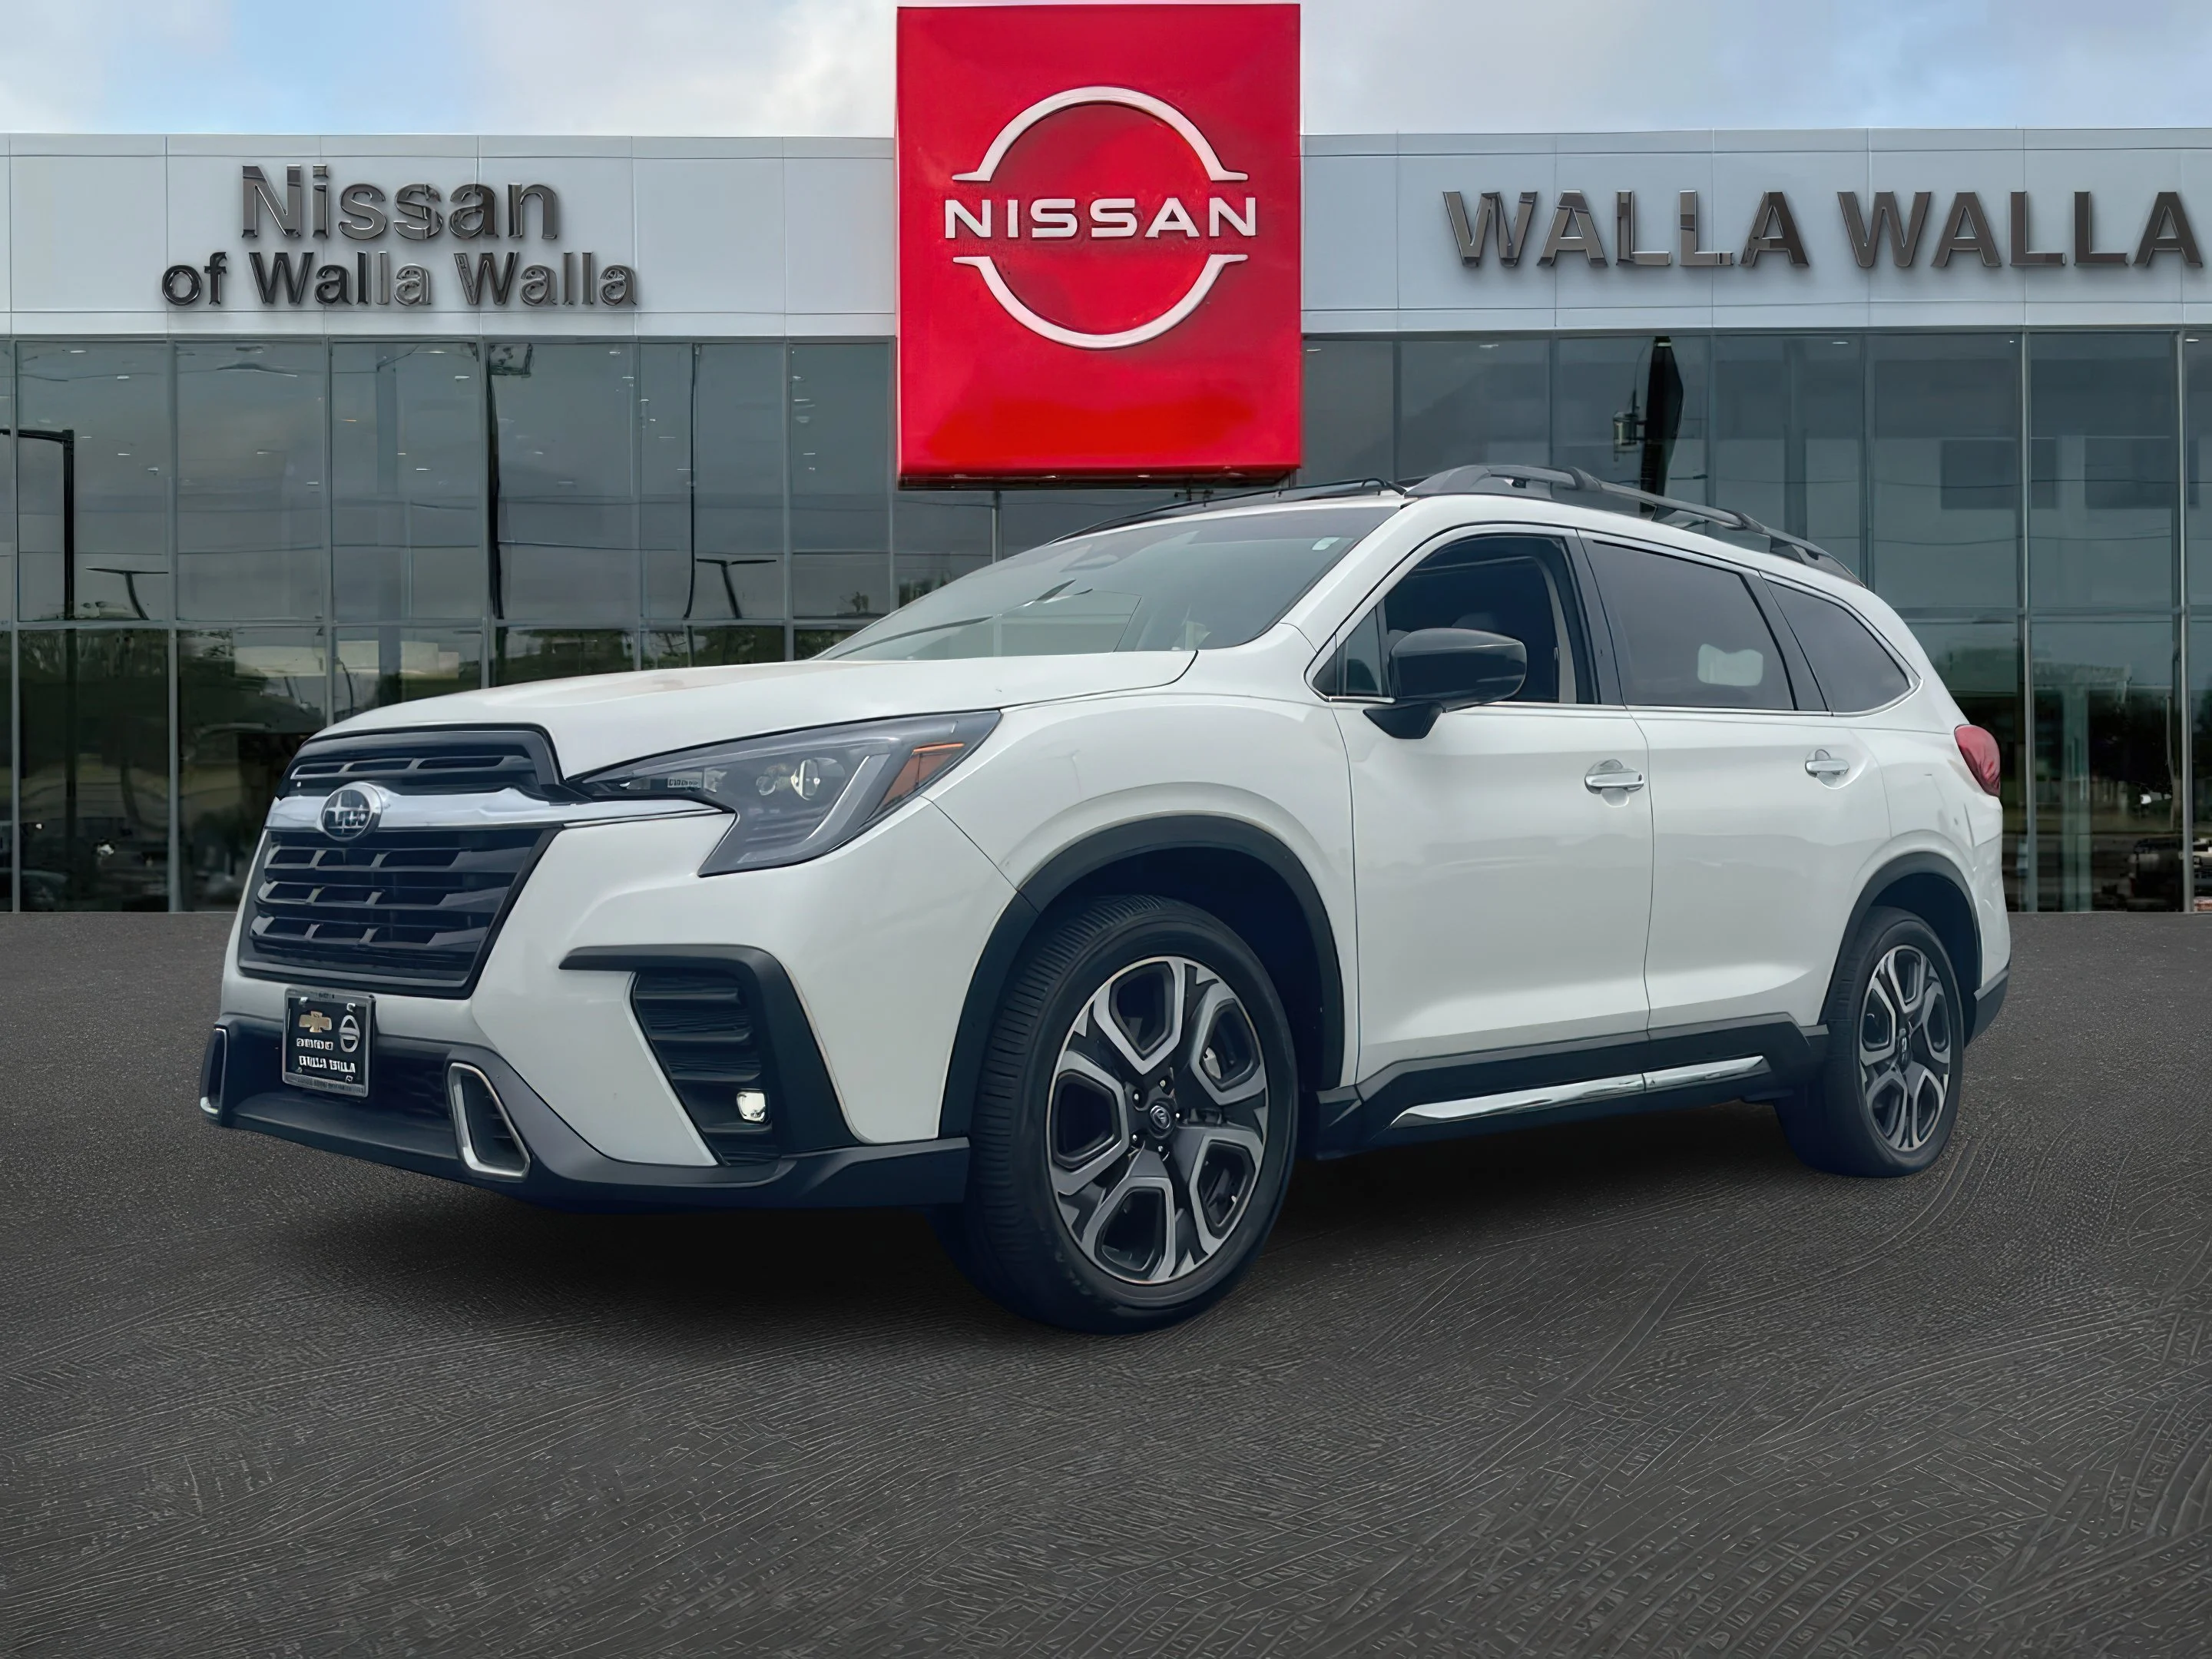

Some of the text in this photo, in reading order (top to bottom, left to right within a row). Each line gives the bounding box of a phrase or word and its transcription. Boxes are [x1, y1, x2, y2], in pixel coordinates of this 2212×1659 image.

[242, 164, 558, 240] Nissan
[945, 197, 1257, 239] NISSAN
[1442, 190, 2204, 267] WALLA WALLA
[161, 250, 638, 306] of Walla Walla
